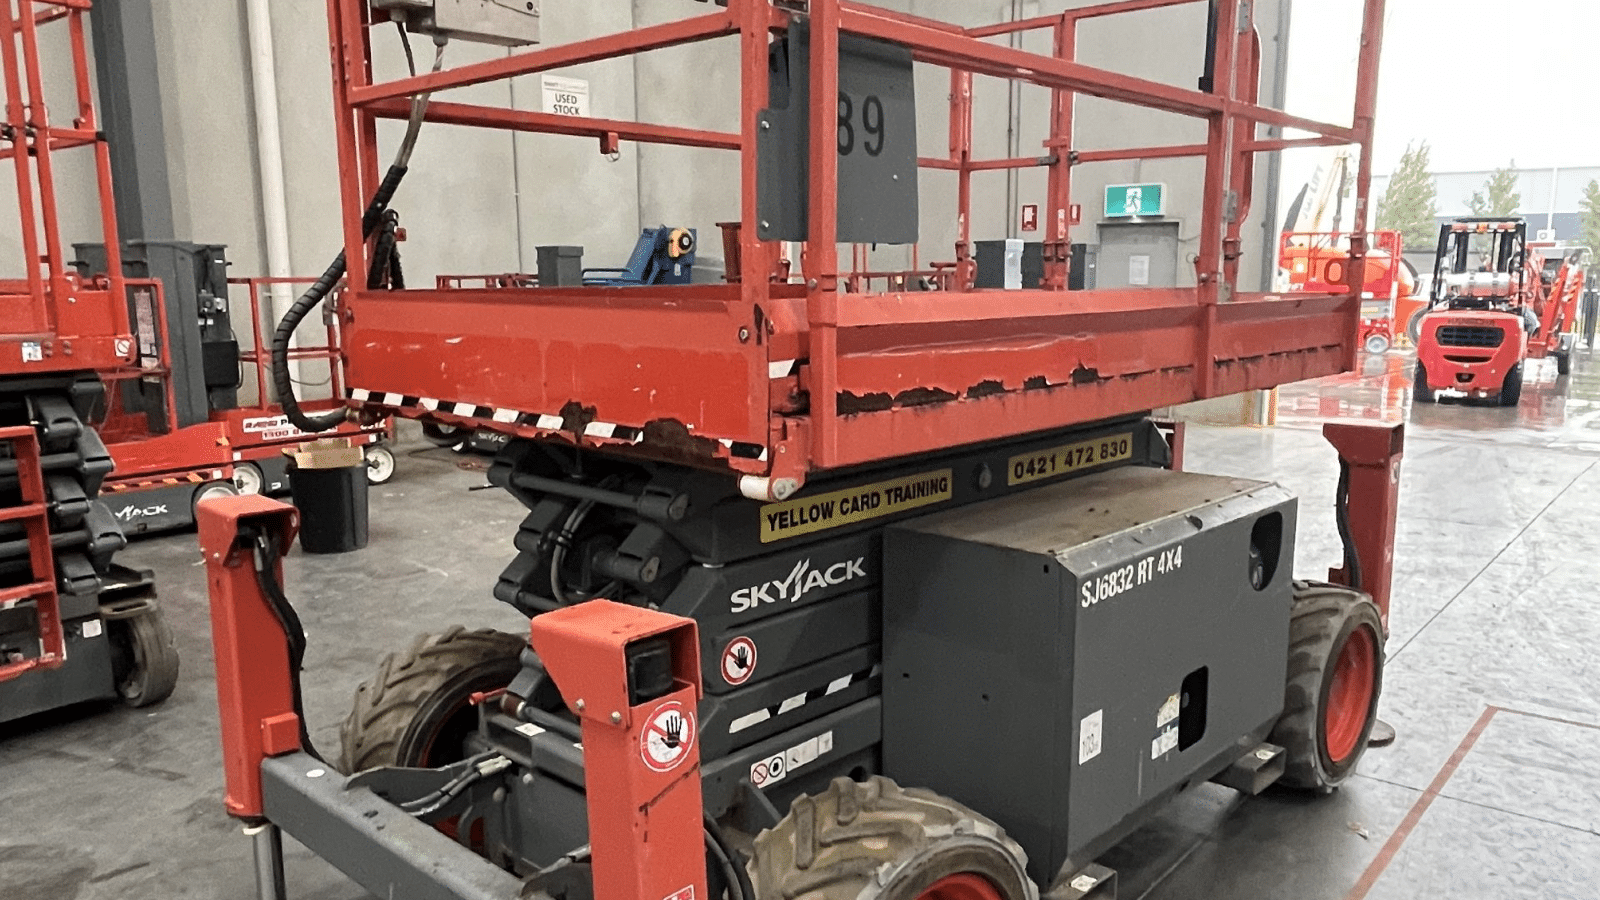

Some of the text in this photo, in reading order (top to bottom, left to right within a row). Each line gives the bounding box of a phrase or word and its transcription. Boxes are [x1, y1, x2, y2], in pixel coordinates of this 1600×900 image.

[553, 104, 580, 115] STOCK
[555, 93, 577, 104] USED
[1014, 440, 1127, 479] 0421 472 830
[767, 477, 948, 531] YELLOW CARD TRAINING
[730, 557, 867, 613] SKYJACK
[1081, 545, 1183, 608] SJ6832 RT 4X4
